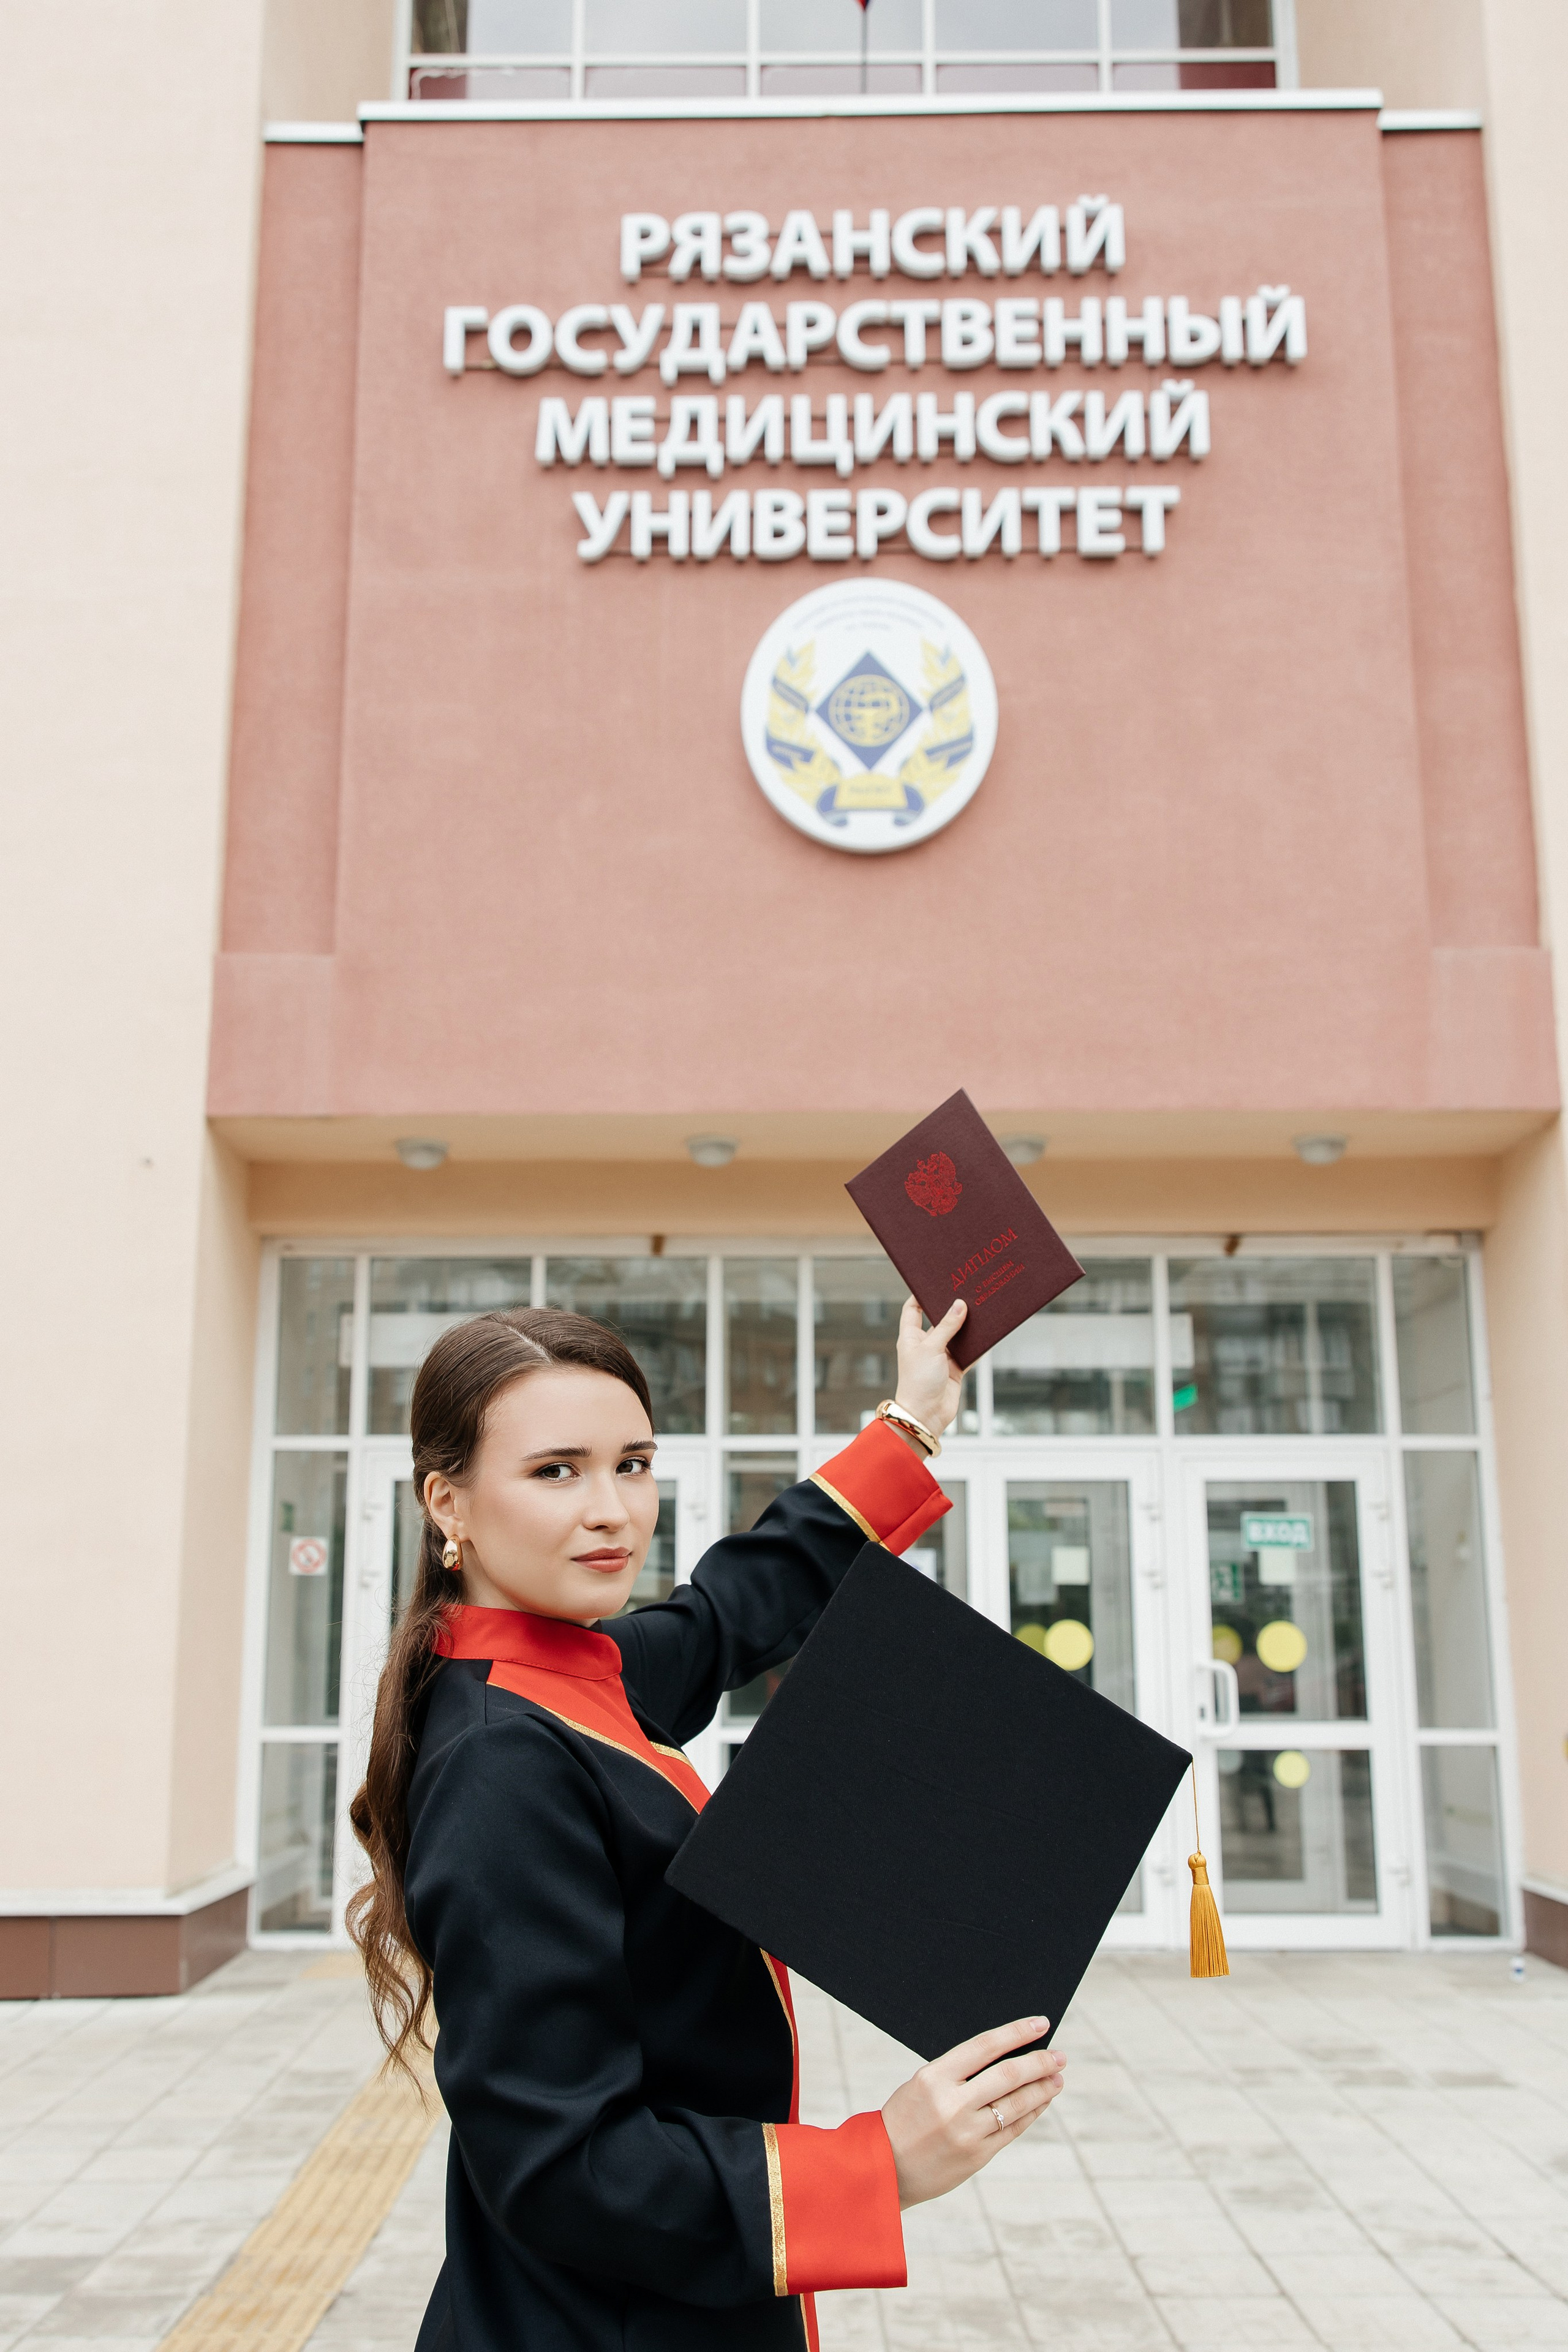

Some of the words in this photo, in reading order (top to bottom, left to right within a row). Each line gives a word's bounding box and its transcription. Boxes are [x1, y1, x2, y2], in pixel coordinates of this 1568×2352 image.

[620, 195, 1126, 280] РЯЗАНСКИЙ
[443, 285, 1308, 383] ГОСУДАРСТВЕННЫЙ
[535, 380, 1210, 477] МЕДИЦИНСКИЙ
[572, 486, 1180, 560] УНИВЕРСИТЕТ
[951, 1227, 1018, 1291] ДИПЛОМ
[974, 1264, 1025, 1305] ОБРАЗОВАНИИ
[982, 1261, 1014, 1287] ВЫСШЕМ
